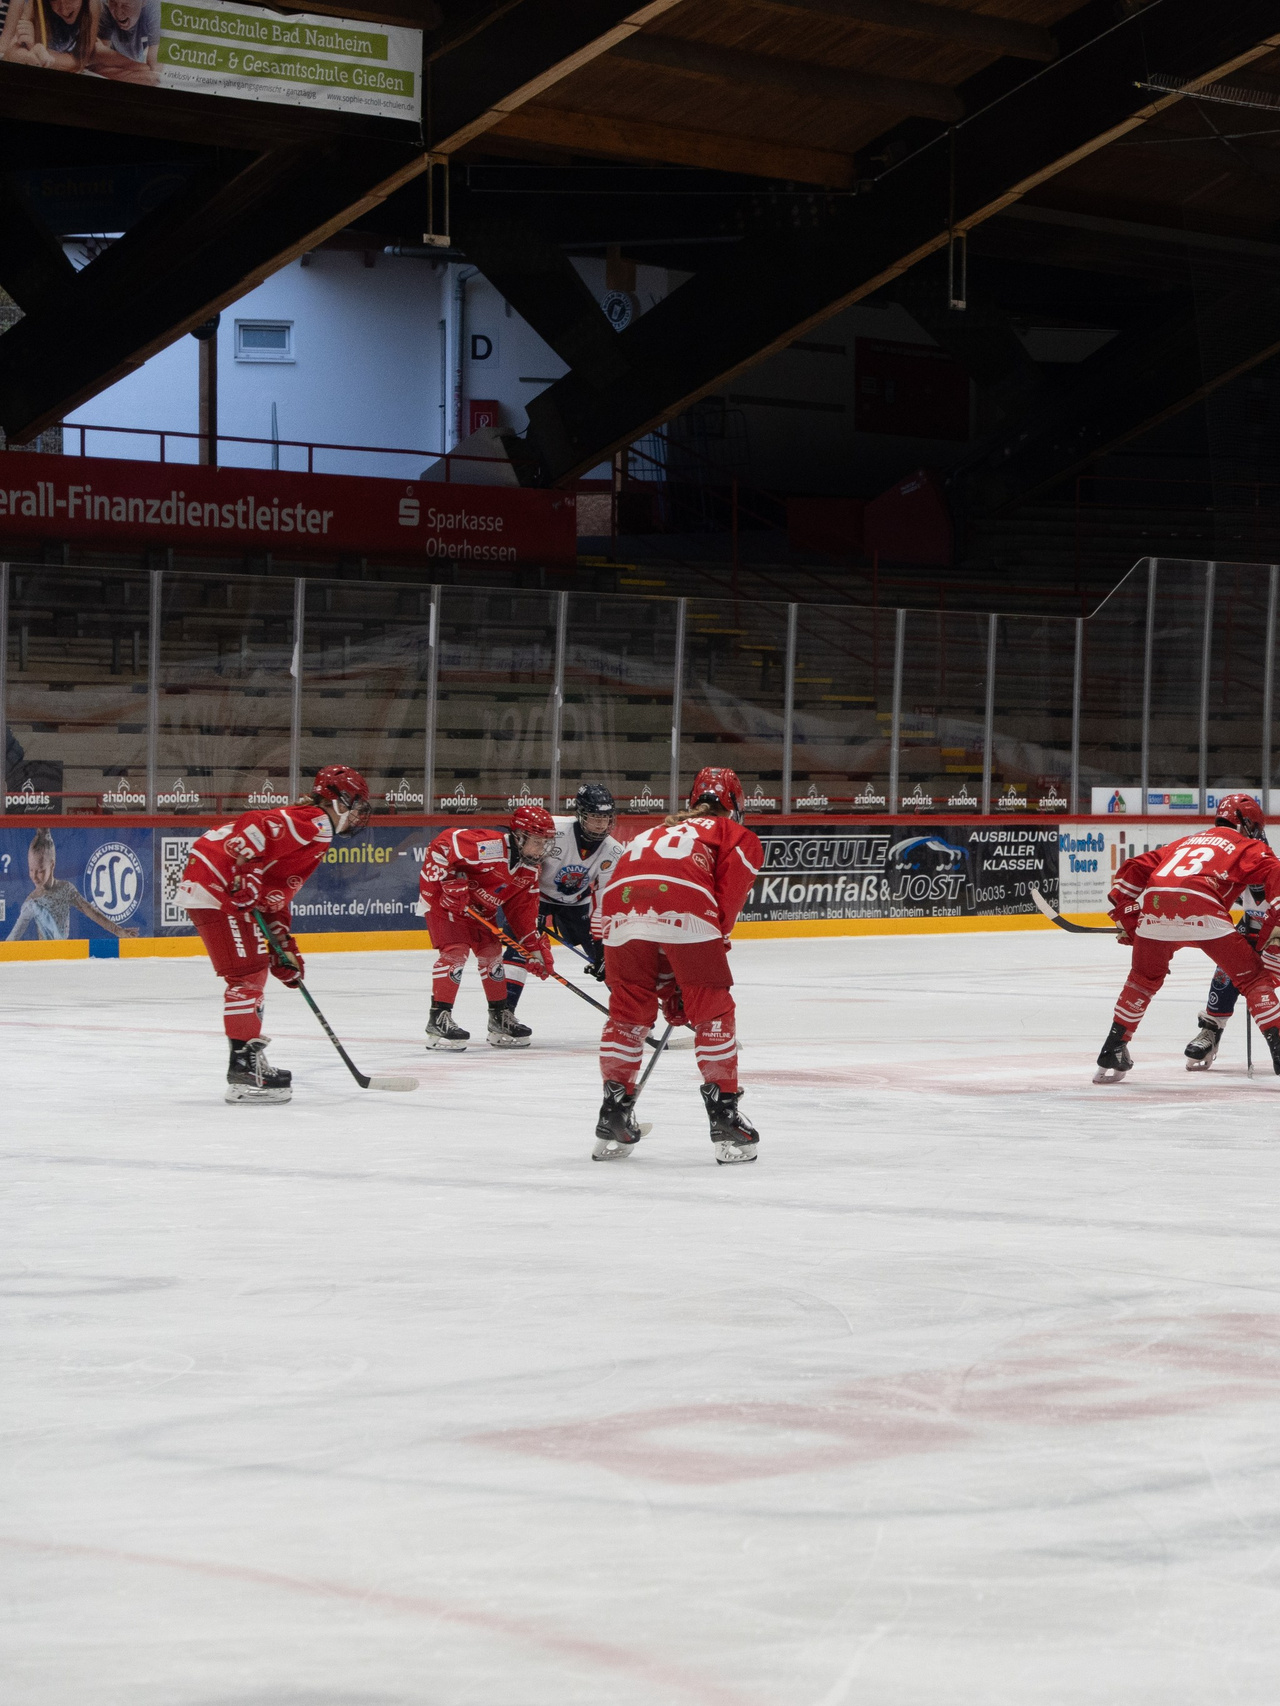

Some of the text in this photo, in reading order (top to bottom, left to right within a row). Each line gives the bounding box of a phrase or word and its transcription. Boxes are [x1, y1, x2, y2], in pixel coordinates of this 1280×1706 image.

[170, 8, 373, 54] Grundschule Bad Nauheim
[168, 42, 404, 92] Grund- & Gesamtschule Gießen
[471, 334, 493, 360] D
[427, 508, 504, 533] Sparkasse
[426, 537, 517, 562] Oberhessen
[5, 791, 50, 808] poolaris
[157, 790, 200, 807] poolaris
[440, 793, 478, 809] poolaris
[796, 794, 828, 808] poolaris
[902, 794, 932, 808] poolaris
[622, 822, 700, 862] 48
[969, 830, 1058, 843] AUSBILDUNG
[1059, 832, 1105, 854] Klomfaß
[87, 844, 142, 876] EISKUNSTLAUF
[993, 845, 1035, 857] ALLER
[1156, 846, 1215, 878] 13
[983, 859, 1044, 871] KLASSEN
[1068, 854, 1098, 873] Tours
[760, 875, 878, 904] Klomfaß
[880, 879, 892, 901] &
[893, 874, 966, 900] JOST
[975, 884, 1006, 903] 06035
[1014, 881, 1026, 897] 70
[1043, 877, 1060, 894] 377
[770, 909, 818, 921] Wölfersheim
[826, 907, 843, 919] Bad
[844, 907, 881, 919] Nauheim
[890, 905, 924, 918] Dorheim
[932, 905, 961, 917] Echzell
